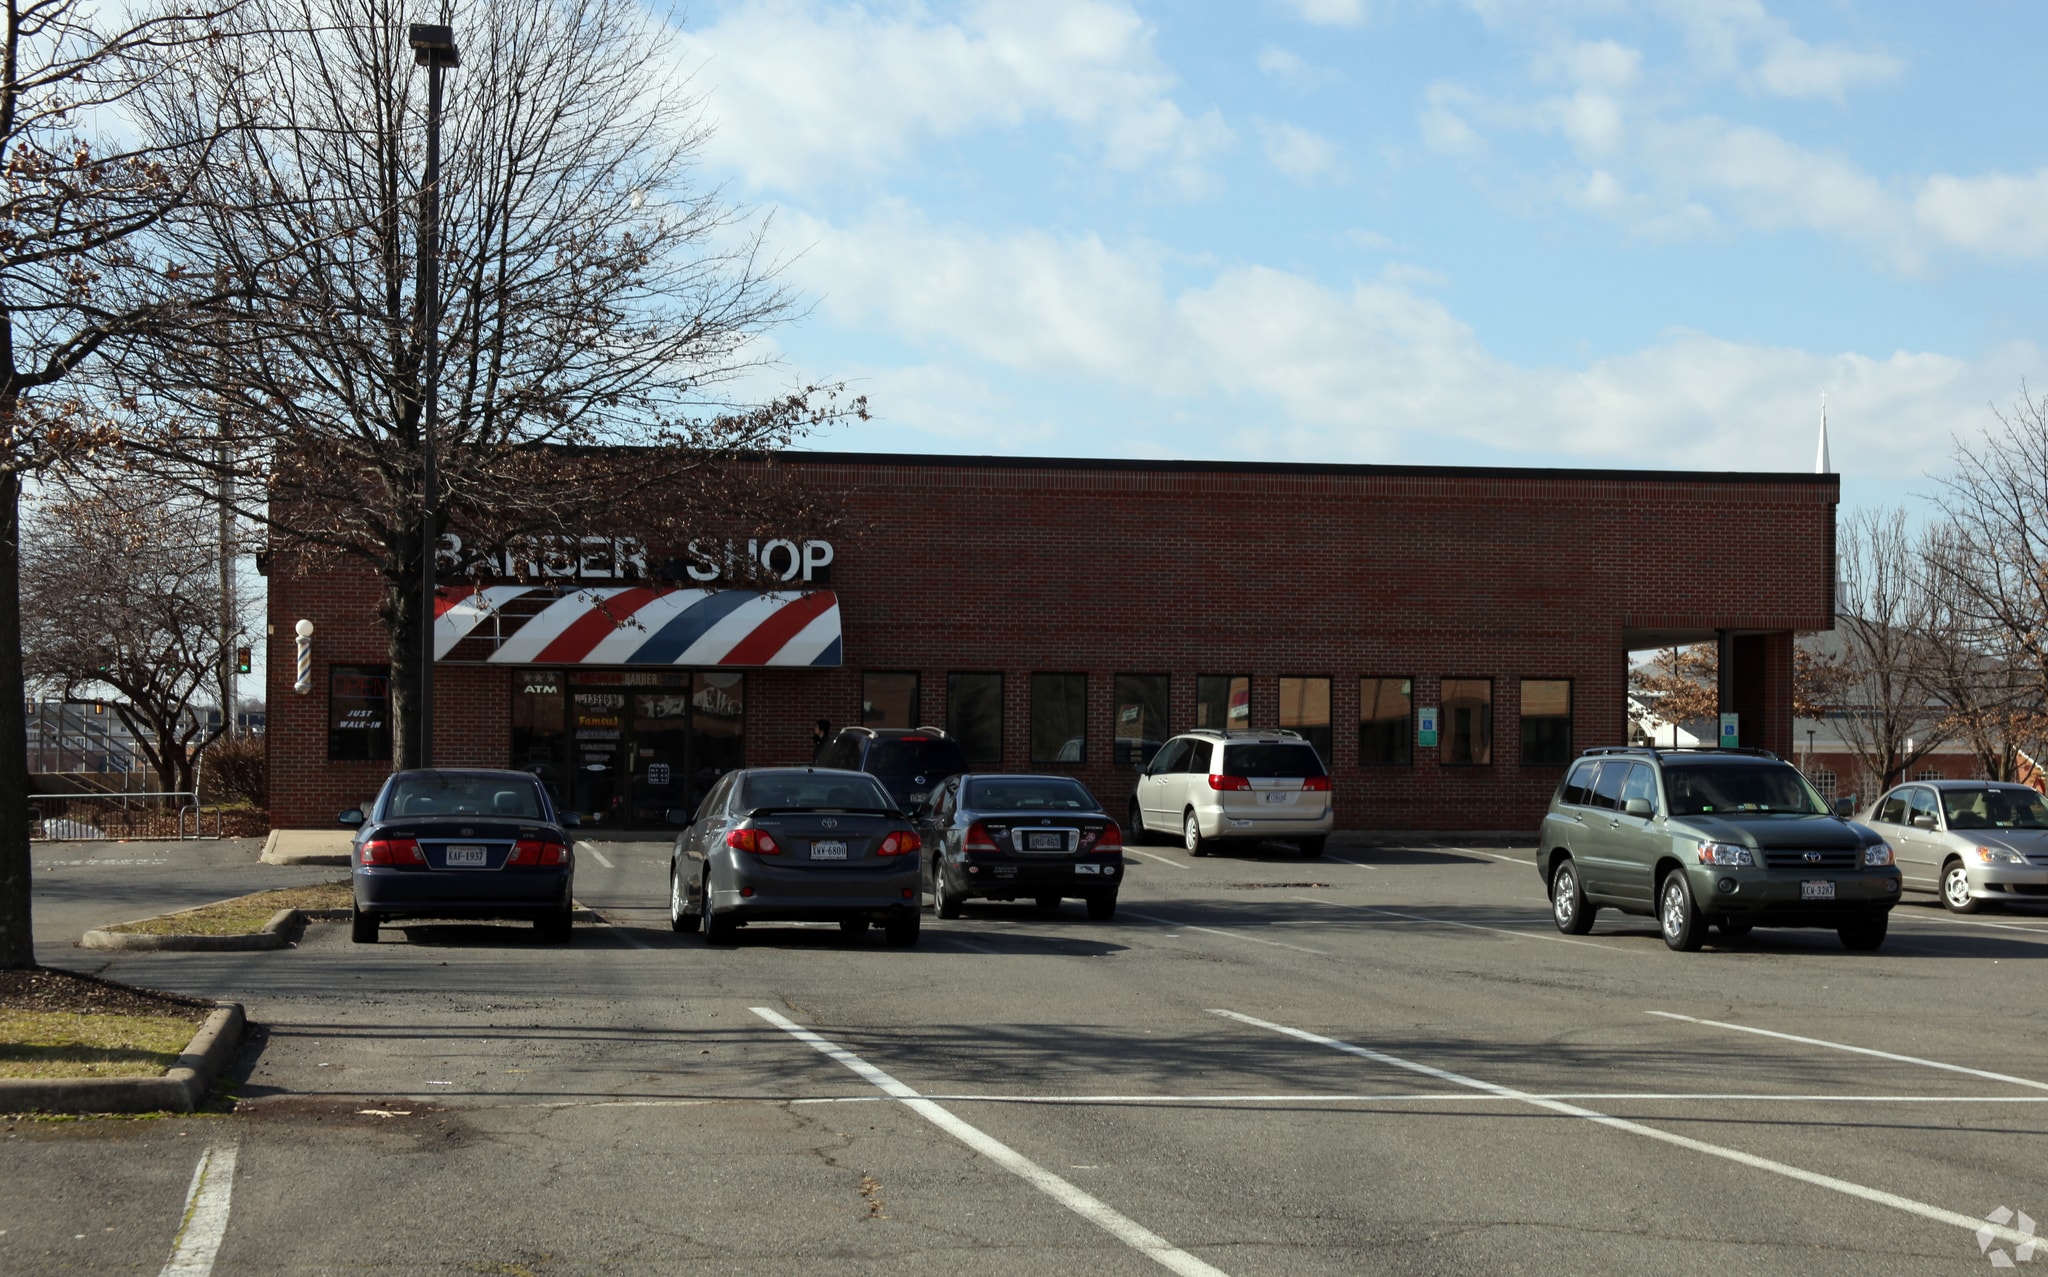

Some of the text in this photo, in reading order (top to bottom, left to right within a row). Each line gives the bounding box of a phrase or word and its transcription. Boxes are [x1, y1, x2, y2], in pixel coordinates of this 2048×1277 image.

[435, 533, 834, 581] BARBER SHOP
[625, 673, 657, 685] BARBER
[334, 675, 388, 698] OPEN
[524, 685, 557, 694] ATM
[339, 721, 382, 729] WALK-IN
